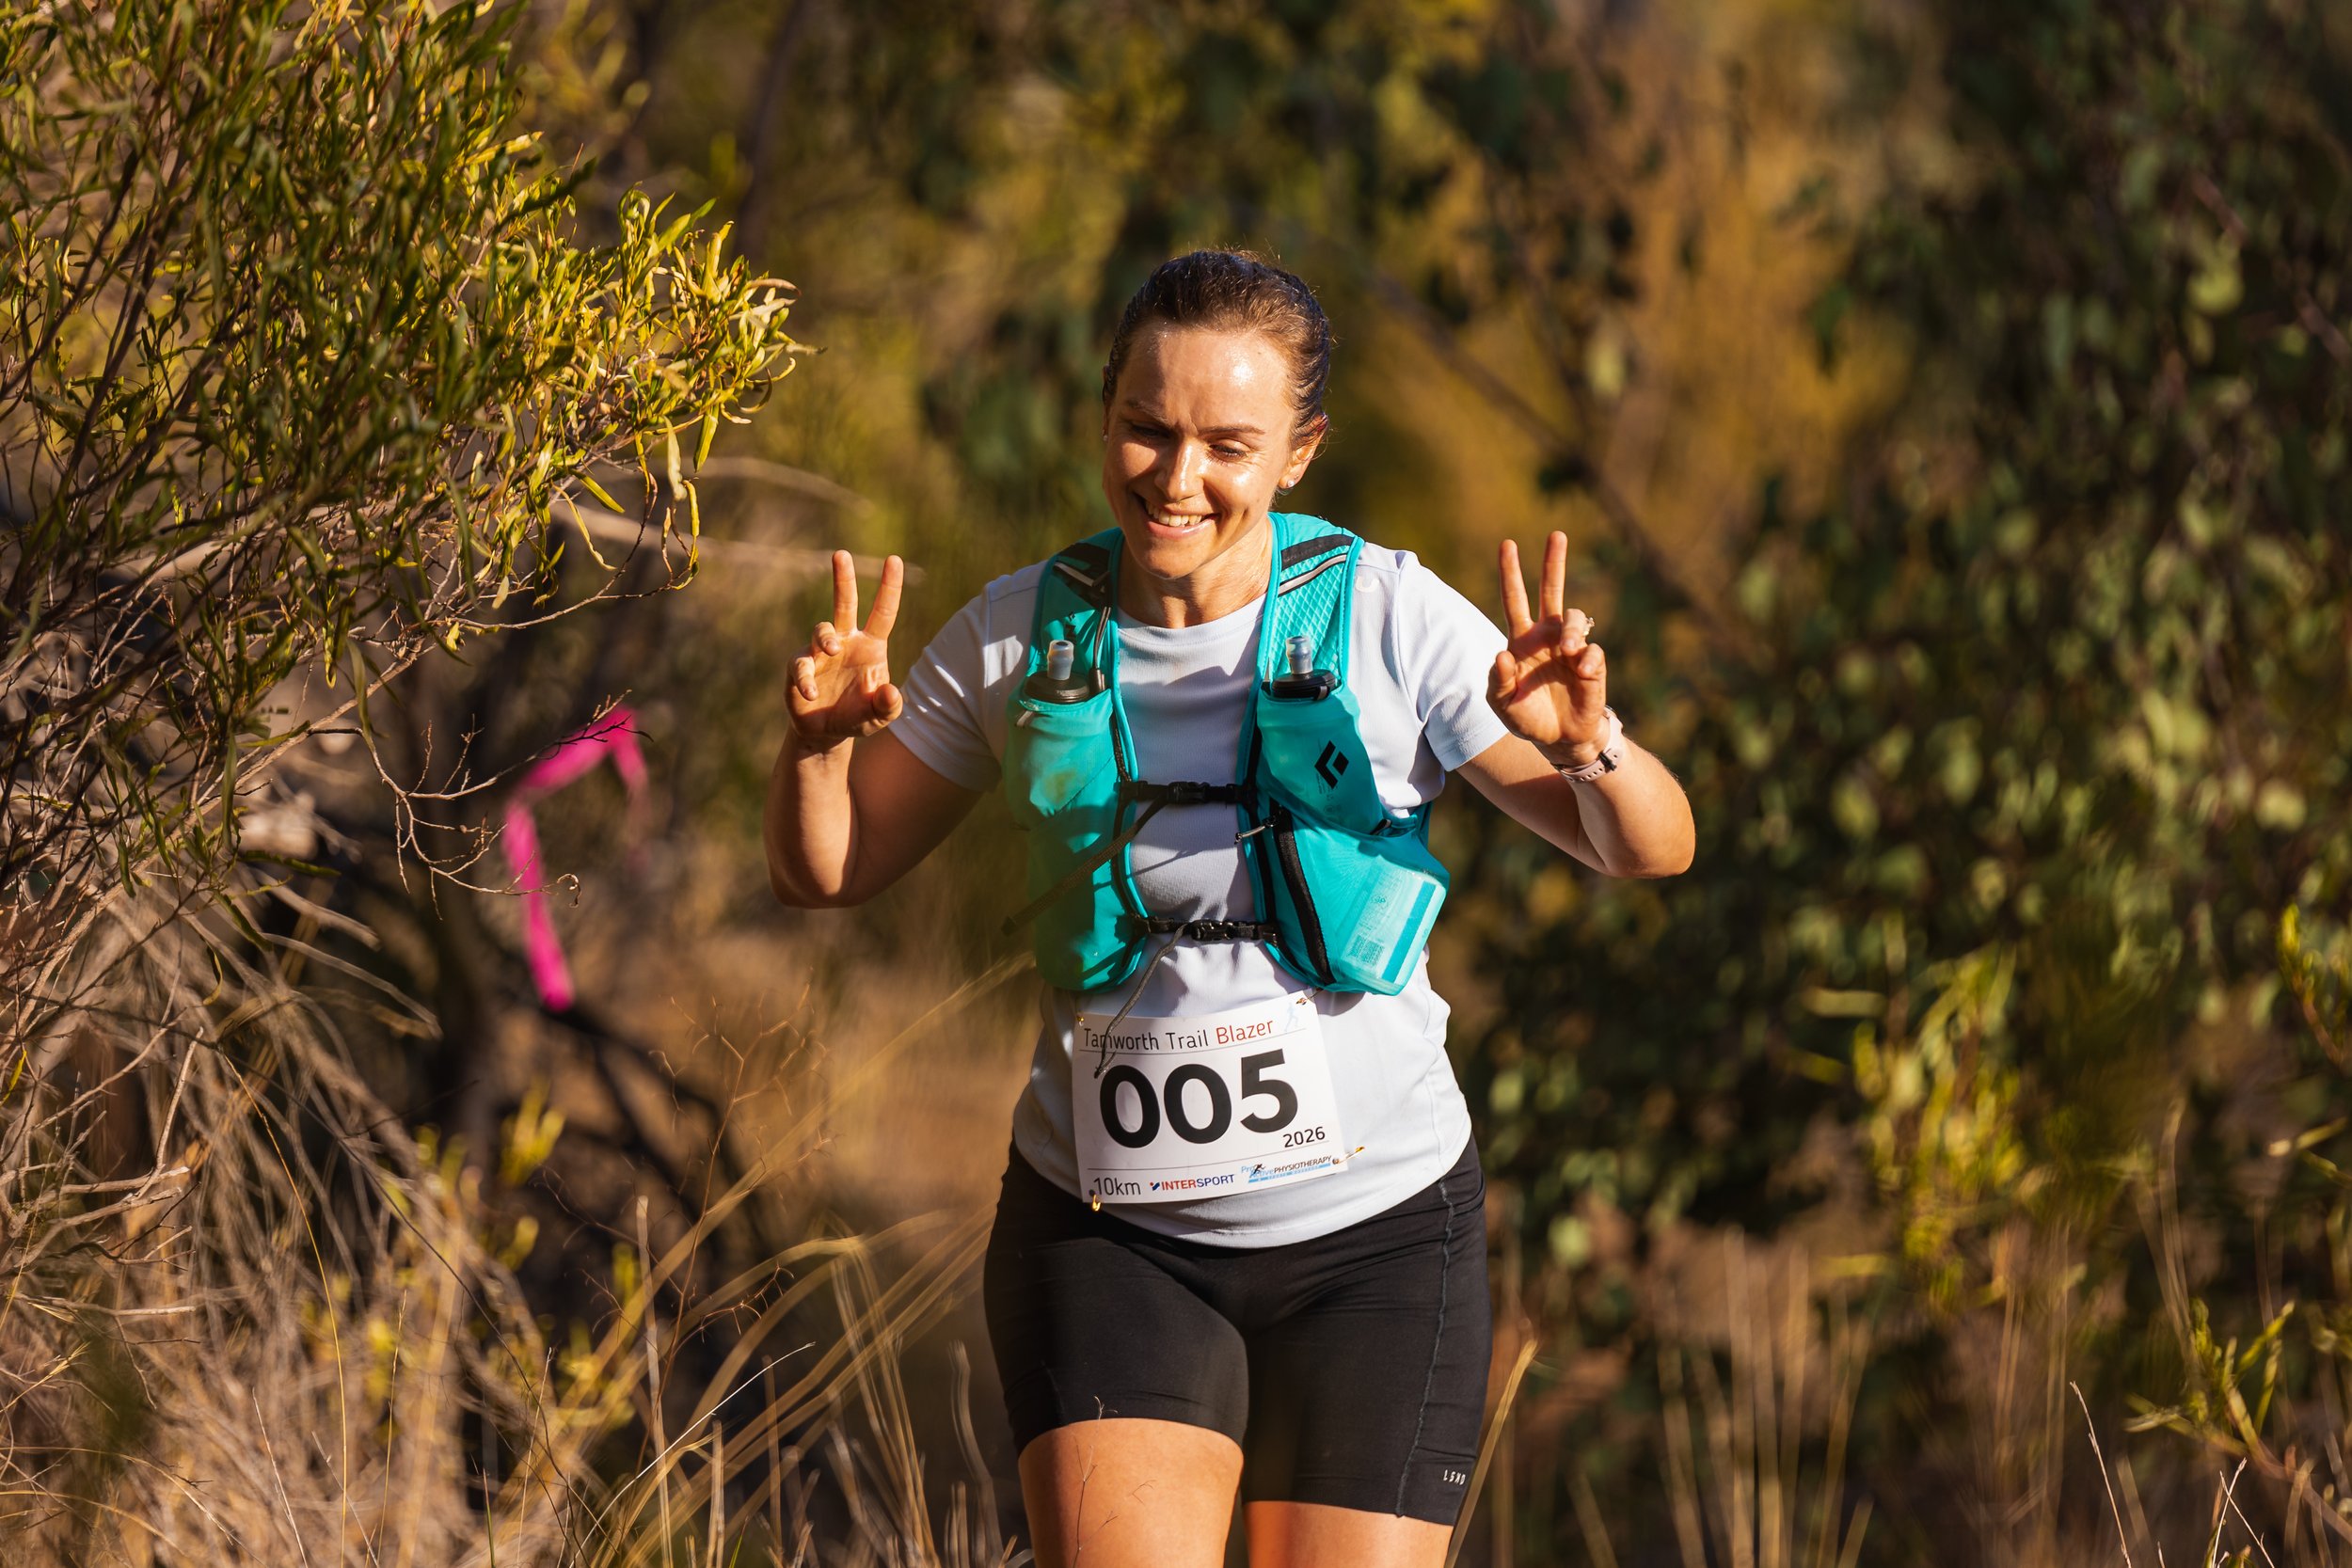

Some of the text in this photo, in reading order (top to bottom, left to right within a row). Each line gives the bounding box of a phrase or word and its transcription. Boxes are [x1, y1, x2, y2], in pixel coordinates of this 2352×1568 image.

[1084, 1020, 1274, 1051] Tamworth Trail Blazer
[1099, 1048, 1298, 1148] 005
[1282, 1126, 1327, 1148] 2026
[1092, 1177, 1141, 1196] 10km
[1161, 1174, 1235, 1191] INTERSPORT
